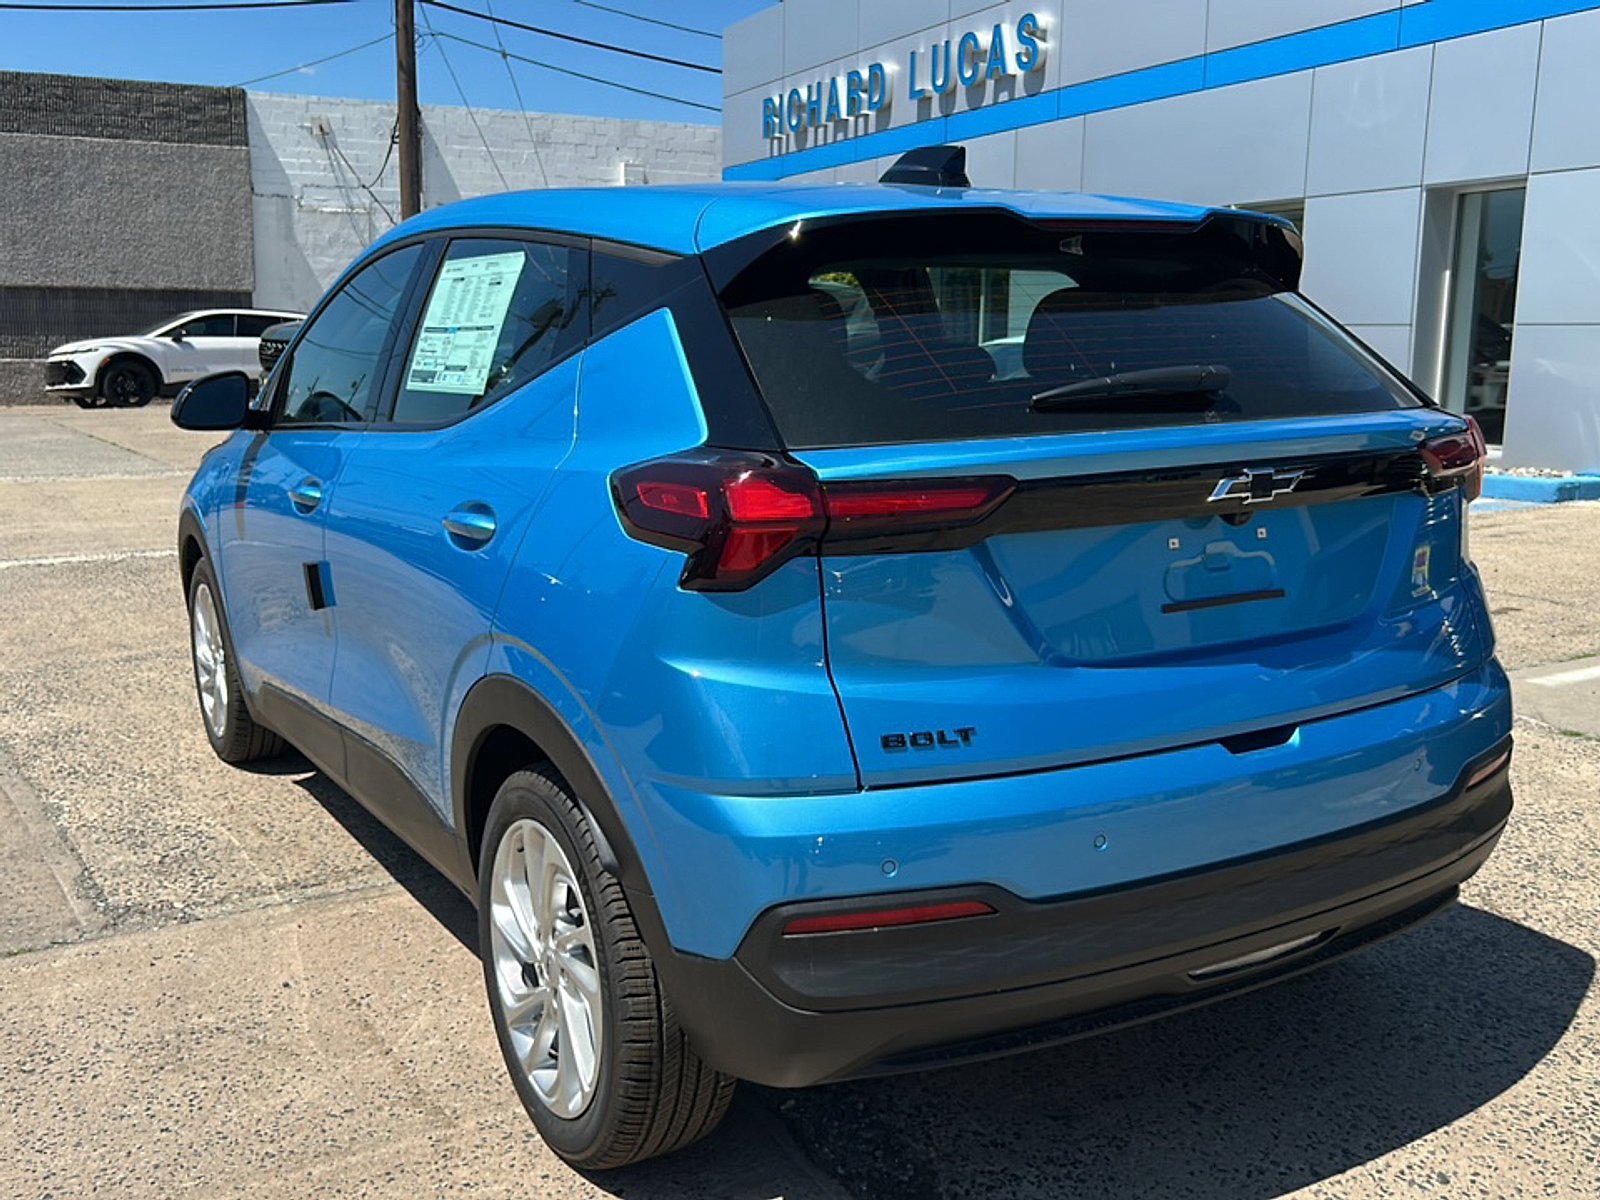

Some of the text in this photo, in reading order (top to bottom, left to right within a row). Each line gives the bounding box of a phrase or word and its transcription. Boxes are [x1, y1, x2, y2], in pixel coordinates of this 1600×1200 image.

[763, 12, 1044, 139] RICHARD LUCAS
[880, 726, 977, 751] BOLT
